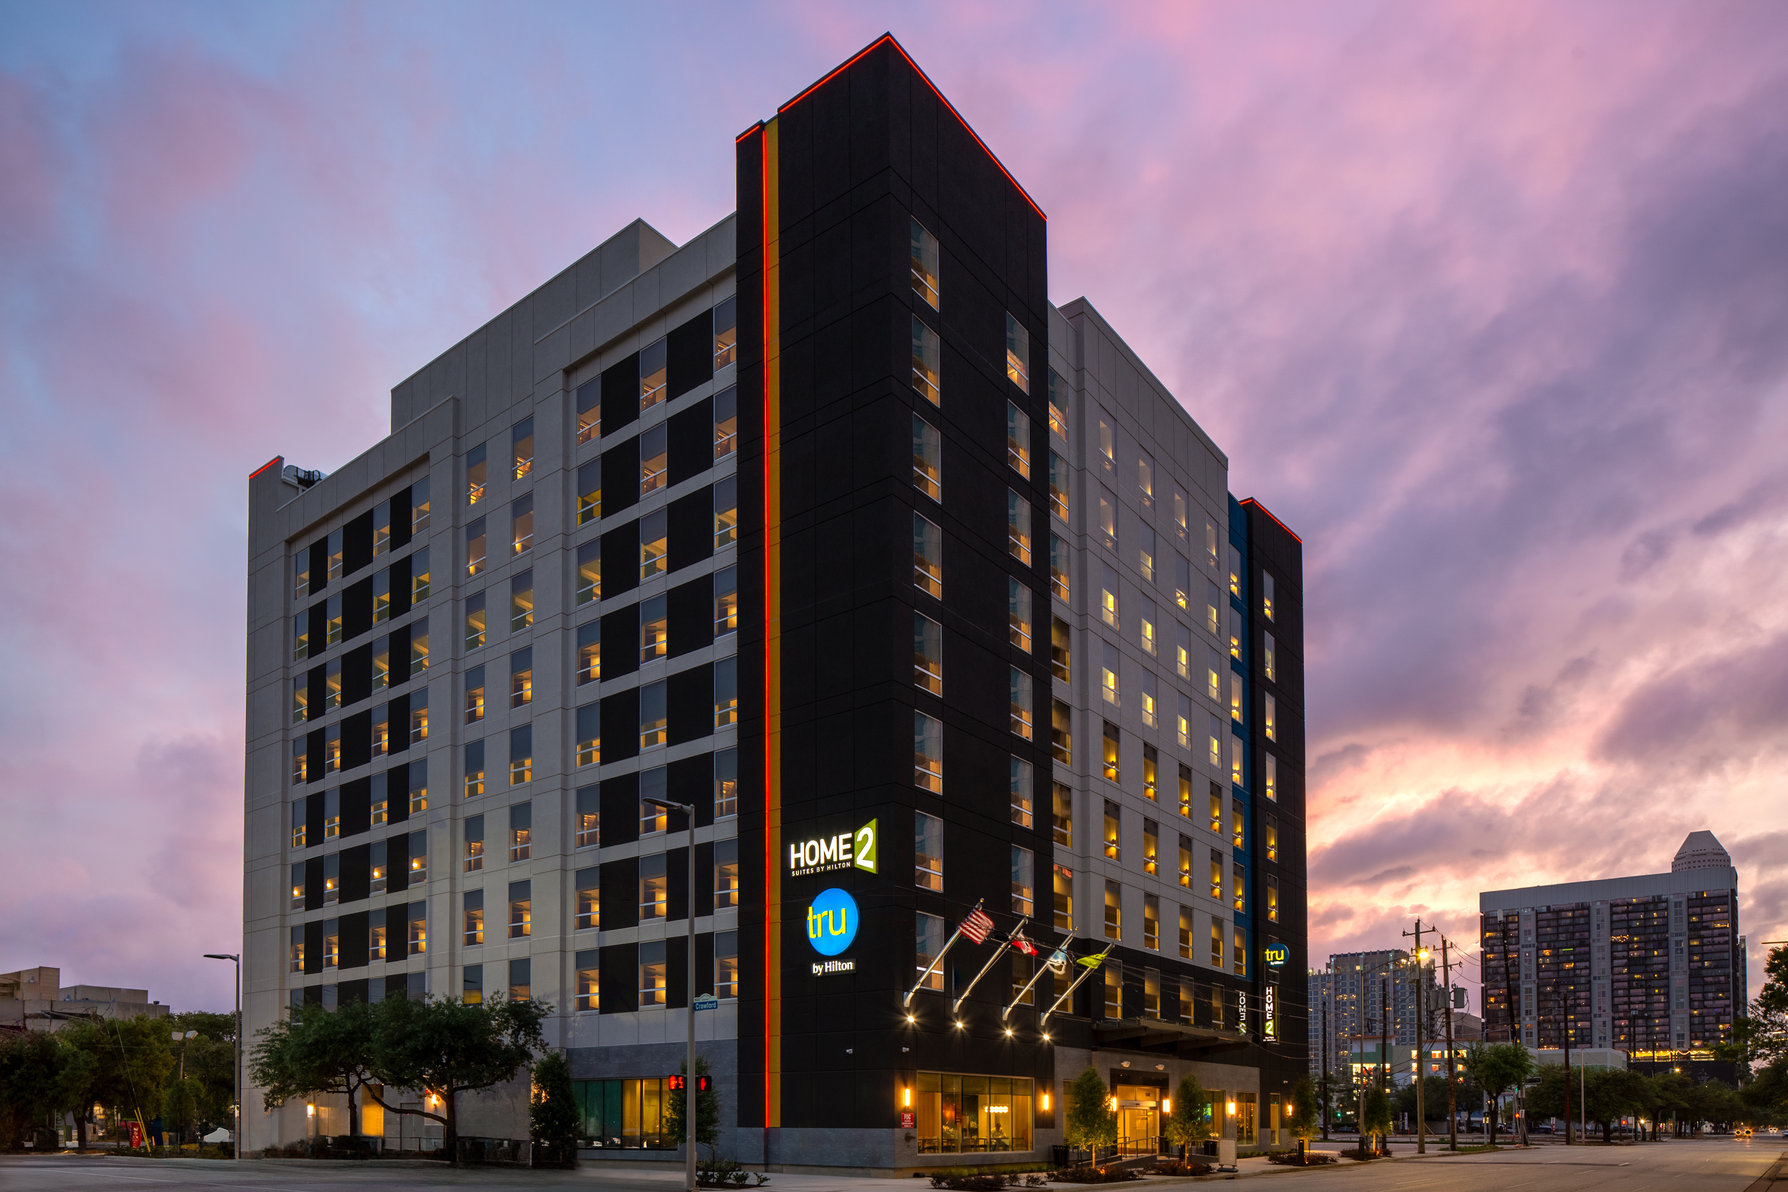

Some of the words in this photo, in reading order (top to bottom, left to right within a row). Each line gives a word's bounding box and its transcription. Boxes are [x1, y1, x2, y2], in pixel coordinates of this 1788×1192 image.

[791, 867, 814, 877] SUITES
[816, 865, 824, 873] BY
[827, 861, 851, 871] HILTON
[807, 906, 846, 939] tru
[1265, 949, 1284, 962] tru
[812, 963, 823, 976] by
[825, 961, 853, 973] Hilton
